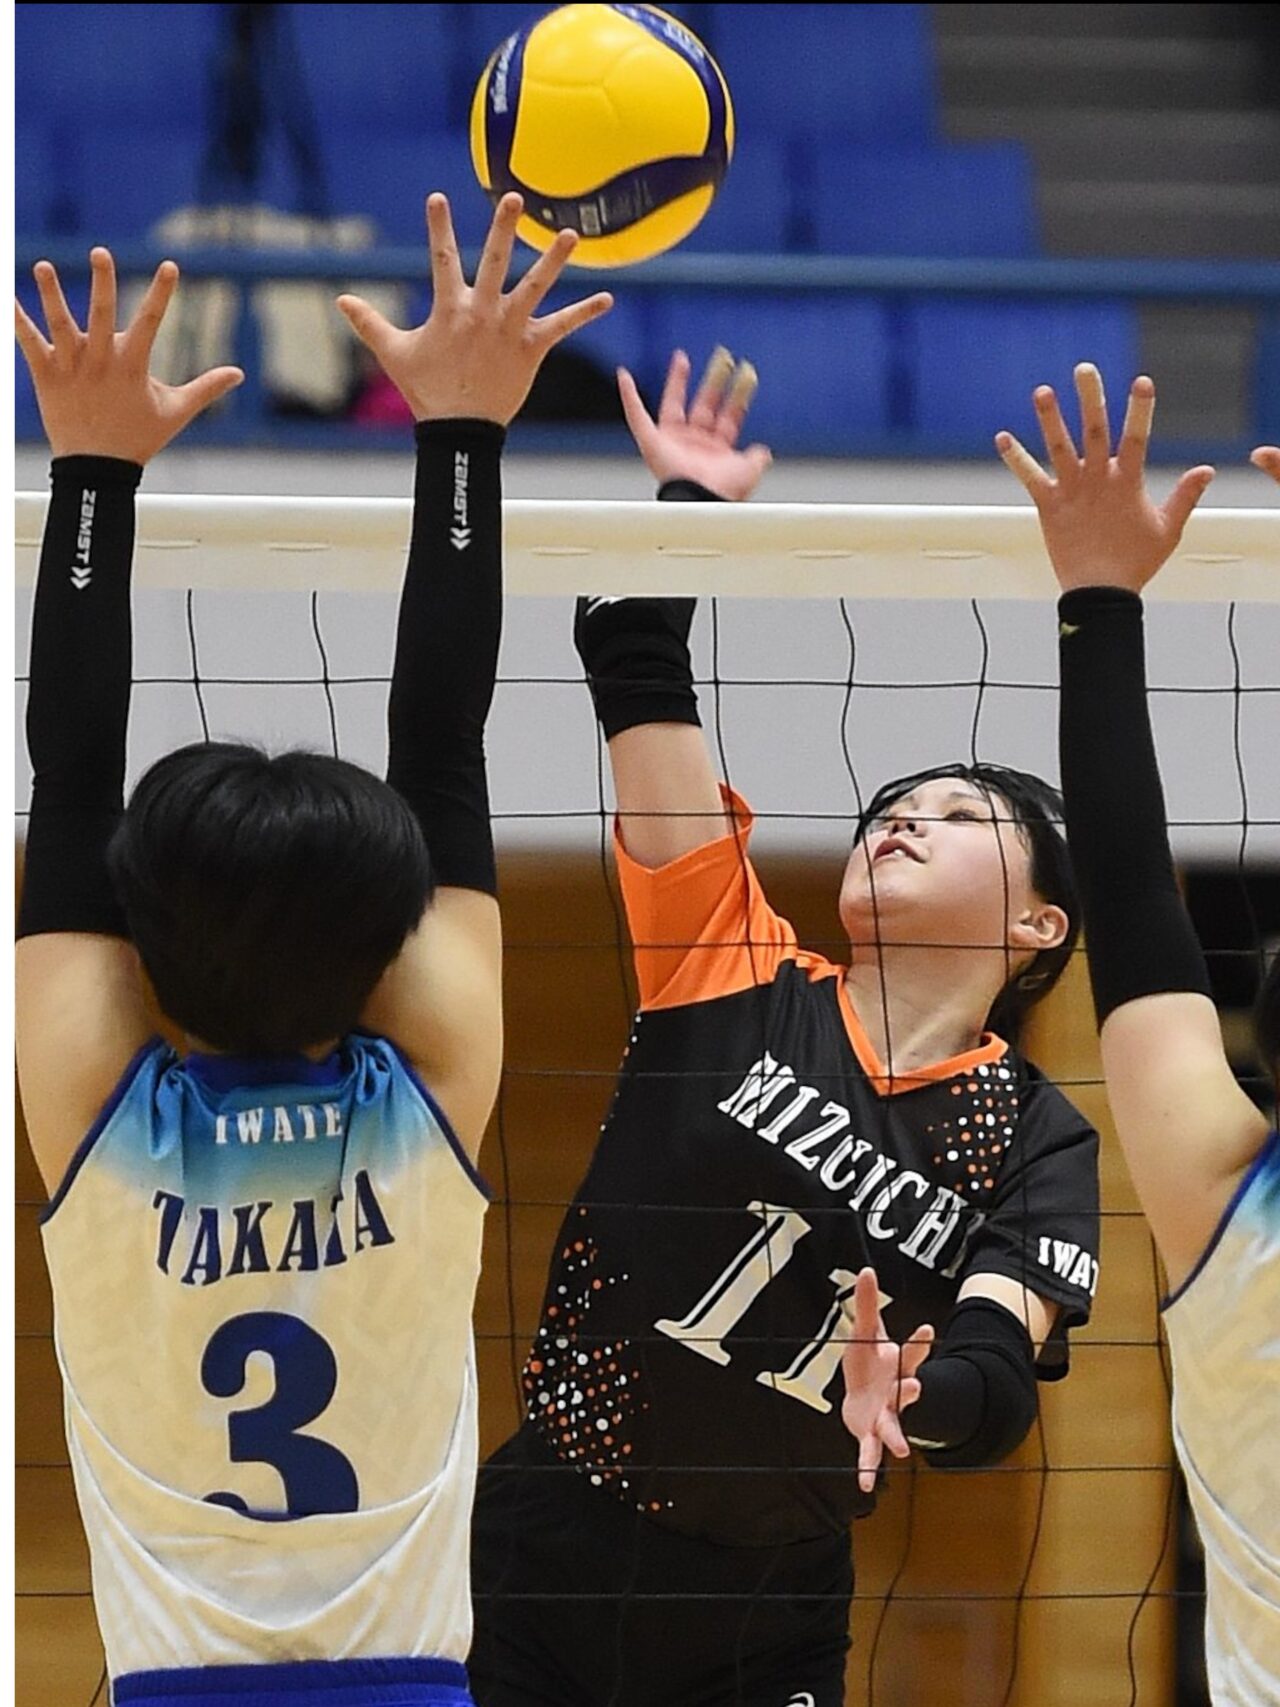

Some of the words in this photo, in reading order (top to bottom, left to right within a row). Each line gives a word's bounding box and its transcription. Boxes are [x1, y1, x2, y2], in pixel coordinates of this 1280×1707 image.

[215, 1102, 344, 1144] IWATE
[653, 1200, 895, 1414] 11
[200, 1311, 360, 1522] 3
